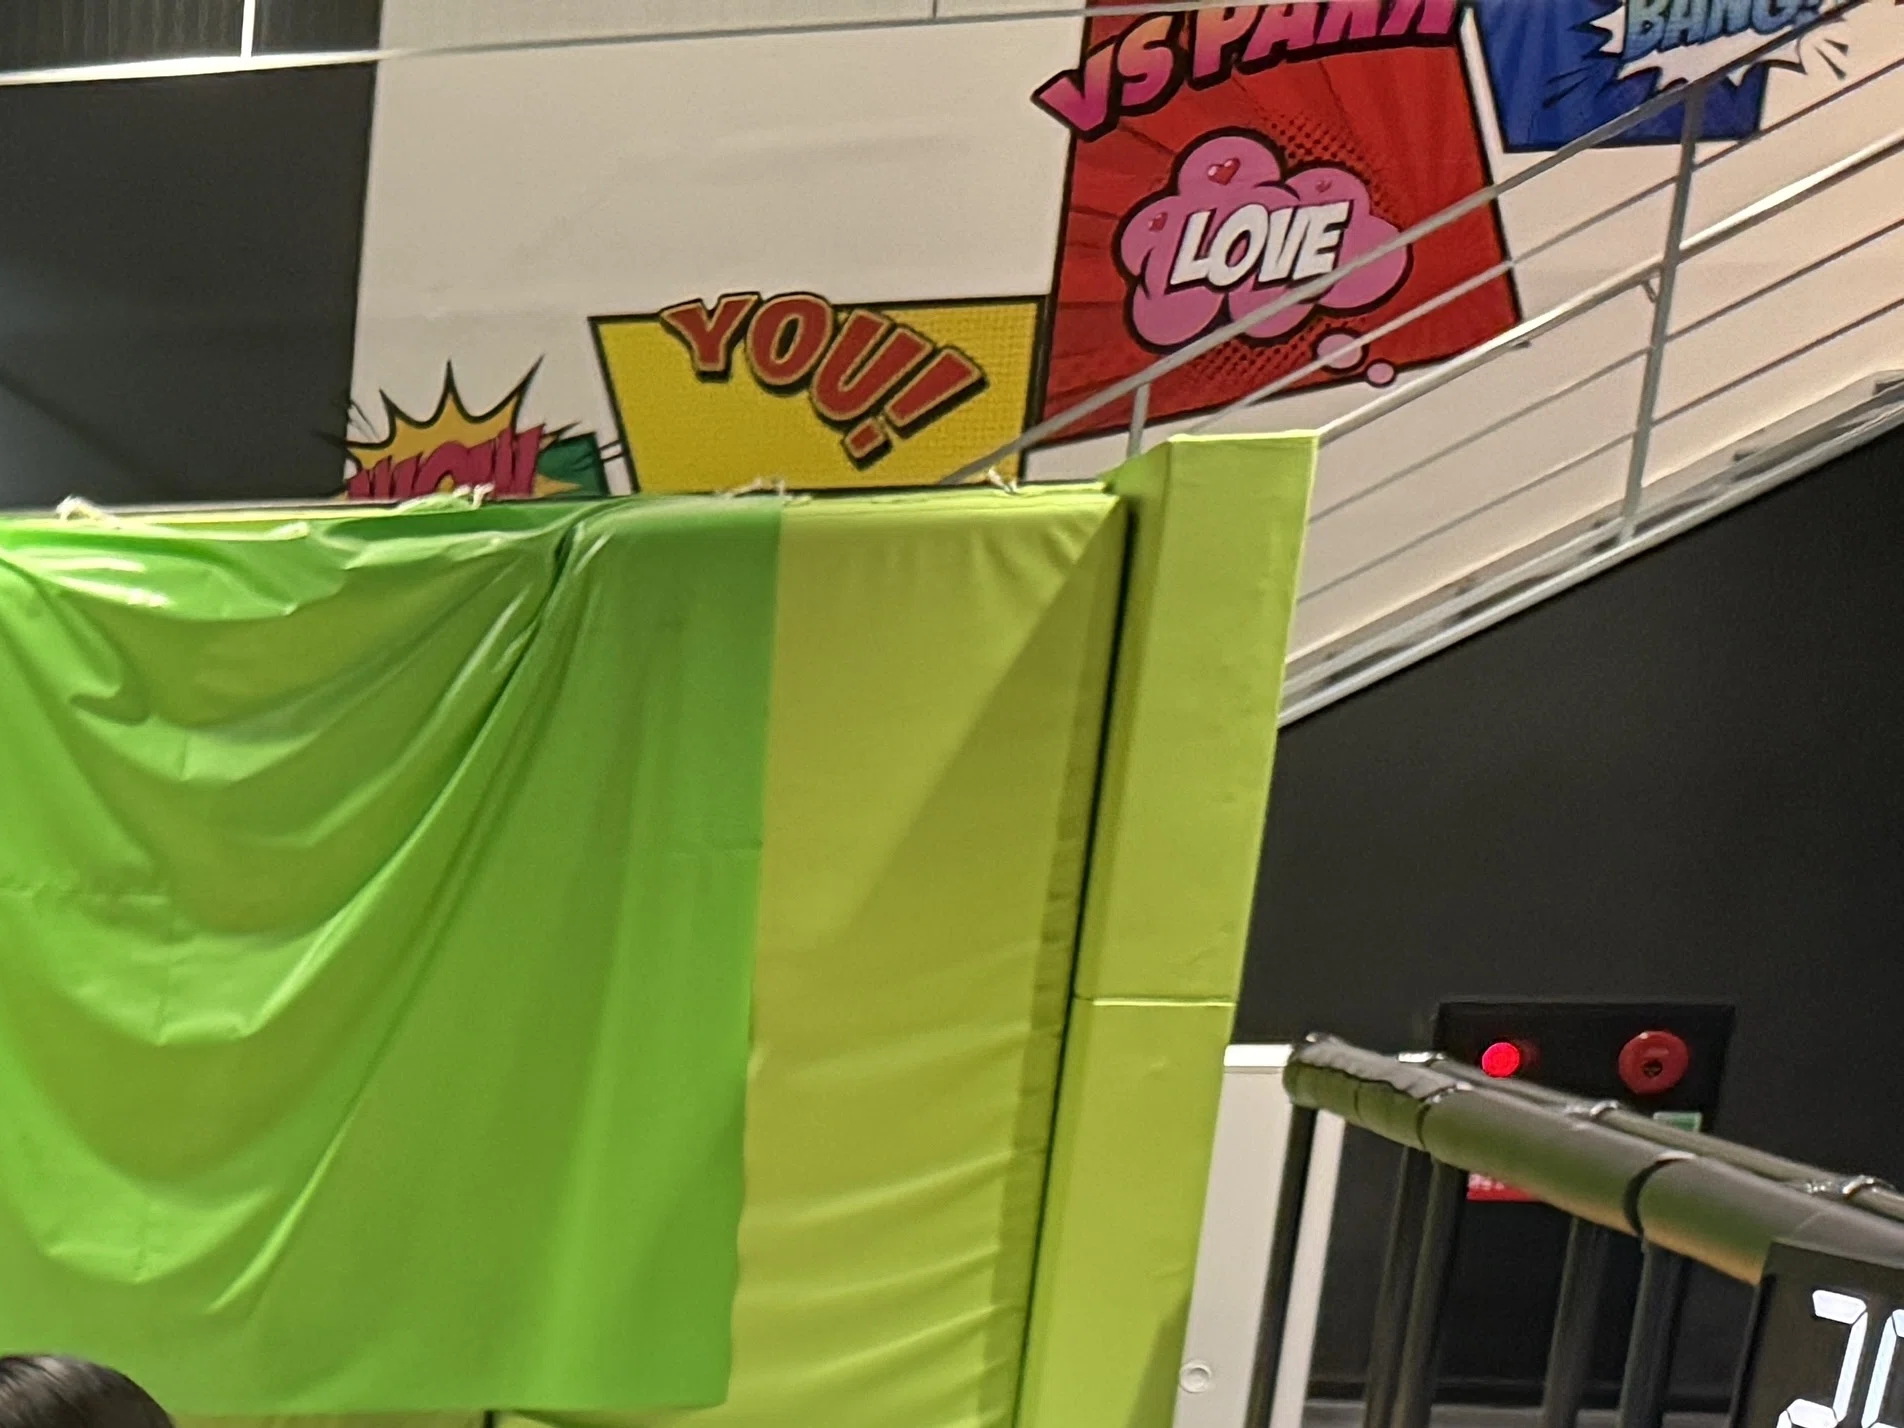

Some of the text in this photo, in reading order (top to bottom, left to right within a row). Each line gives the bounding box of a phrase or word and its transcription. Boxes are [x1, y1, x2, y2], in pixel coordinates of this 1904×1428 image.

[1032, 10, 1182, 142] VS
[1167, 202, 1354, 291] LOVE
[659, 292, 989, 471] YOU!
